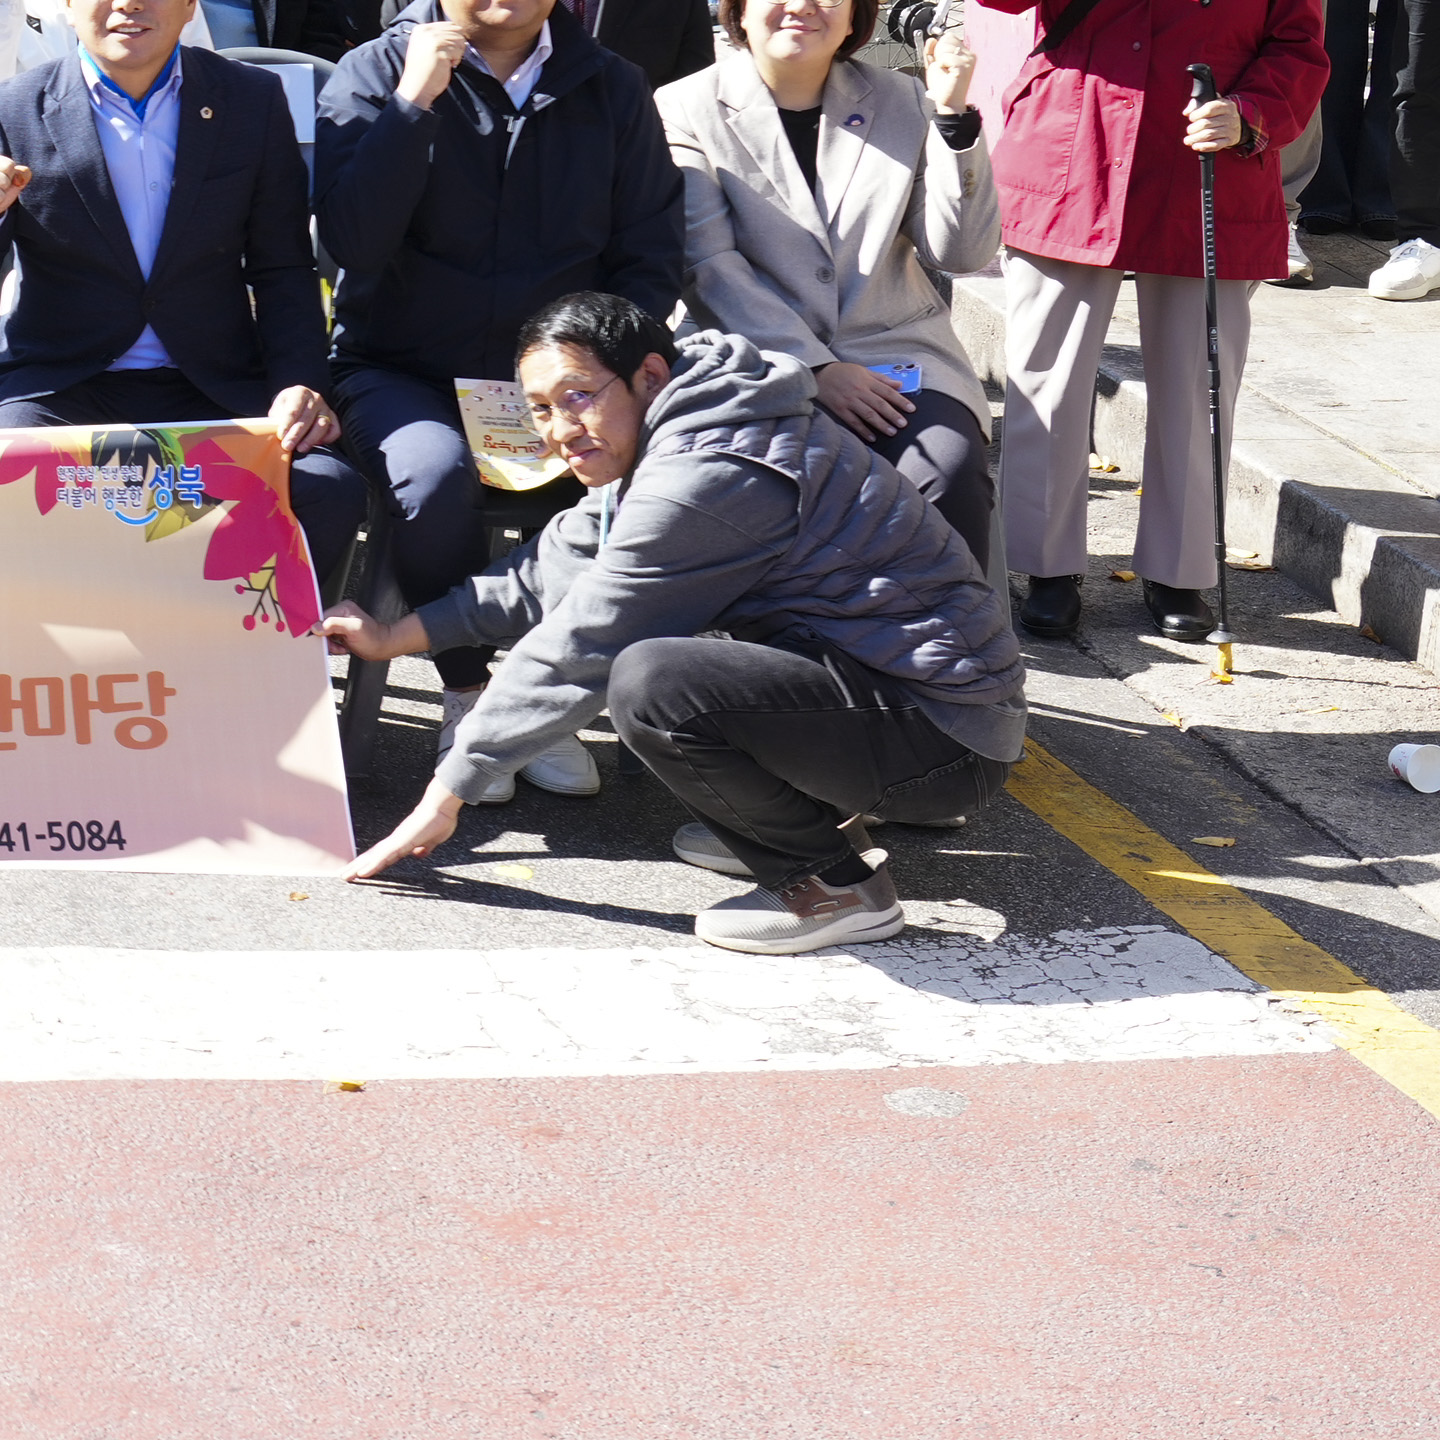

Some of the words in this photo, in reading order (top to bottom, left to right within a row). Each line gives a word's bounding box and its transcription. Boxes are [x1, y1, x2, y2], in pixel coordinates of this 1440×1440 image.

[57, 488, 98, 509] 더불어
[101, 486, 143, 510] 행복한
[148, 464, 206, 509] 성북
